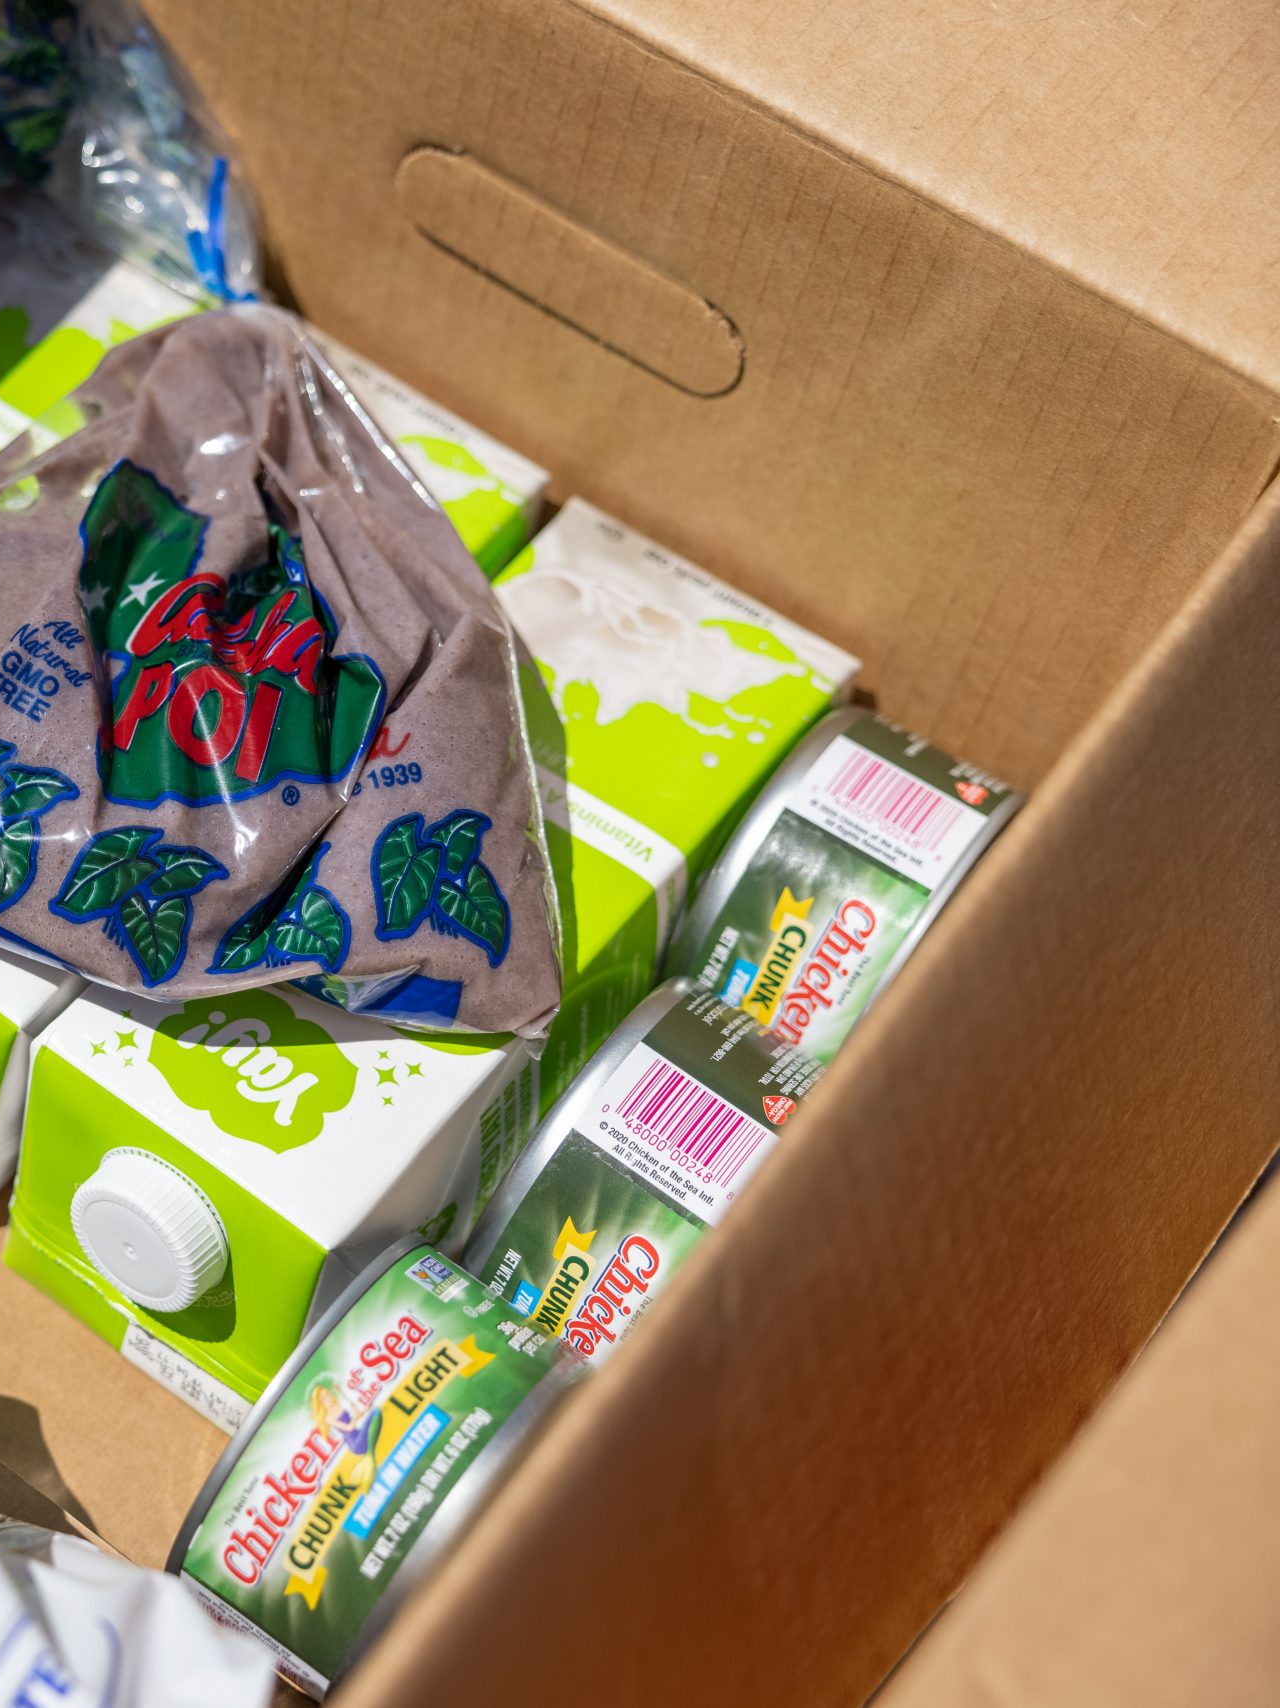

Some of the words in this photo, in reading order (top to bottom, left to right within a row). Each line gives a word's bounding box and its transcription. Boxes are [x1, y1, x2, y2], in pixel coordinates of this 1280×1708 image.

[10, 622, 93, 688] Natural
[43, 620, 85, 650] All
[1, 649, 60, 697] GMO
[103, 659, 283, 783] POI
[367, 761, 423, 790] 1939
[568, 797, 655, 864] Vitamins
[751, 924, 807, 1011] CHUNK
[773, 898, 877, 1046] Chicken
[176, 1010, 320, 1128] Yay!
[608, 1127, 629, 1145] 2020
[627, 1140, 660, 1167] Chicken
[660, 1164, 671, 1174] of
[669, 1170, 684, 1185] the
[683, 1180, 699, 1196] Sea
[612, 1144, 626, 1156] All
[649, 1169, 686, 1201] Reserved.
[625, 1118, 667, 1152] 48000
[670, 1149, 713, 1184] 00248
[505, 1248, 522, 1269] NET
[536, 1255, 590, 1333] CHUNK
[565, 1234, 661, 1356] Chicke
[346, 1367, 365, 1392] of
[358, 1313, 434, 1383] Sea
[356, 1380, 383, 1410] the
[288, 1472, 362, 1571] CHUNK
[388, 1347, 461, 1417] LIGHT
[351, 1481, 390, 1527] TUNA
[396, 1411, 442, 1474] WATER
[222, 1427, 341, 1587] Chicken
[357, 1551, 386, 1580] NET
